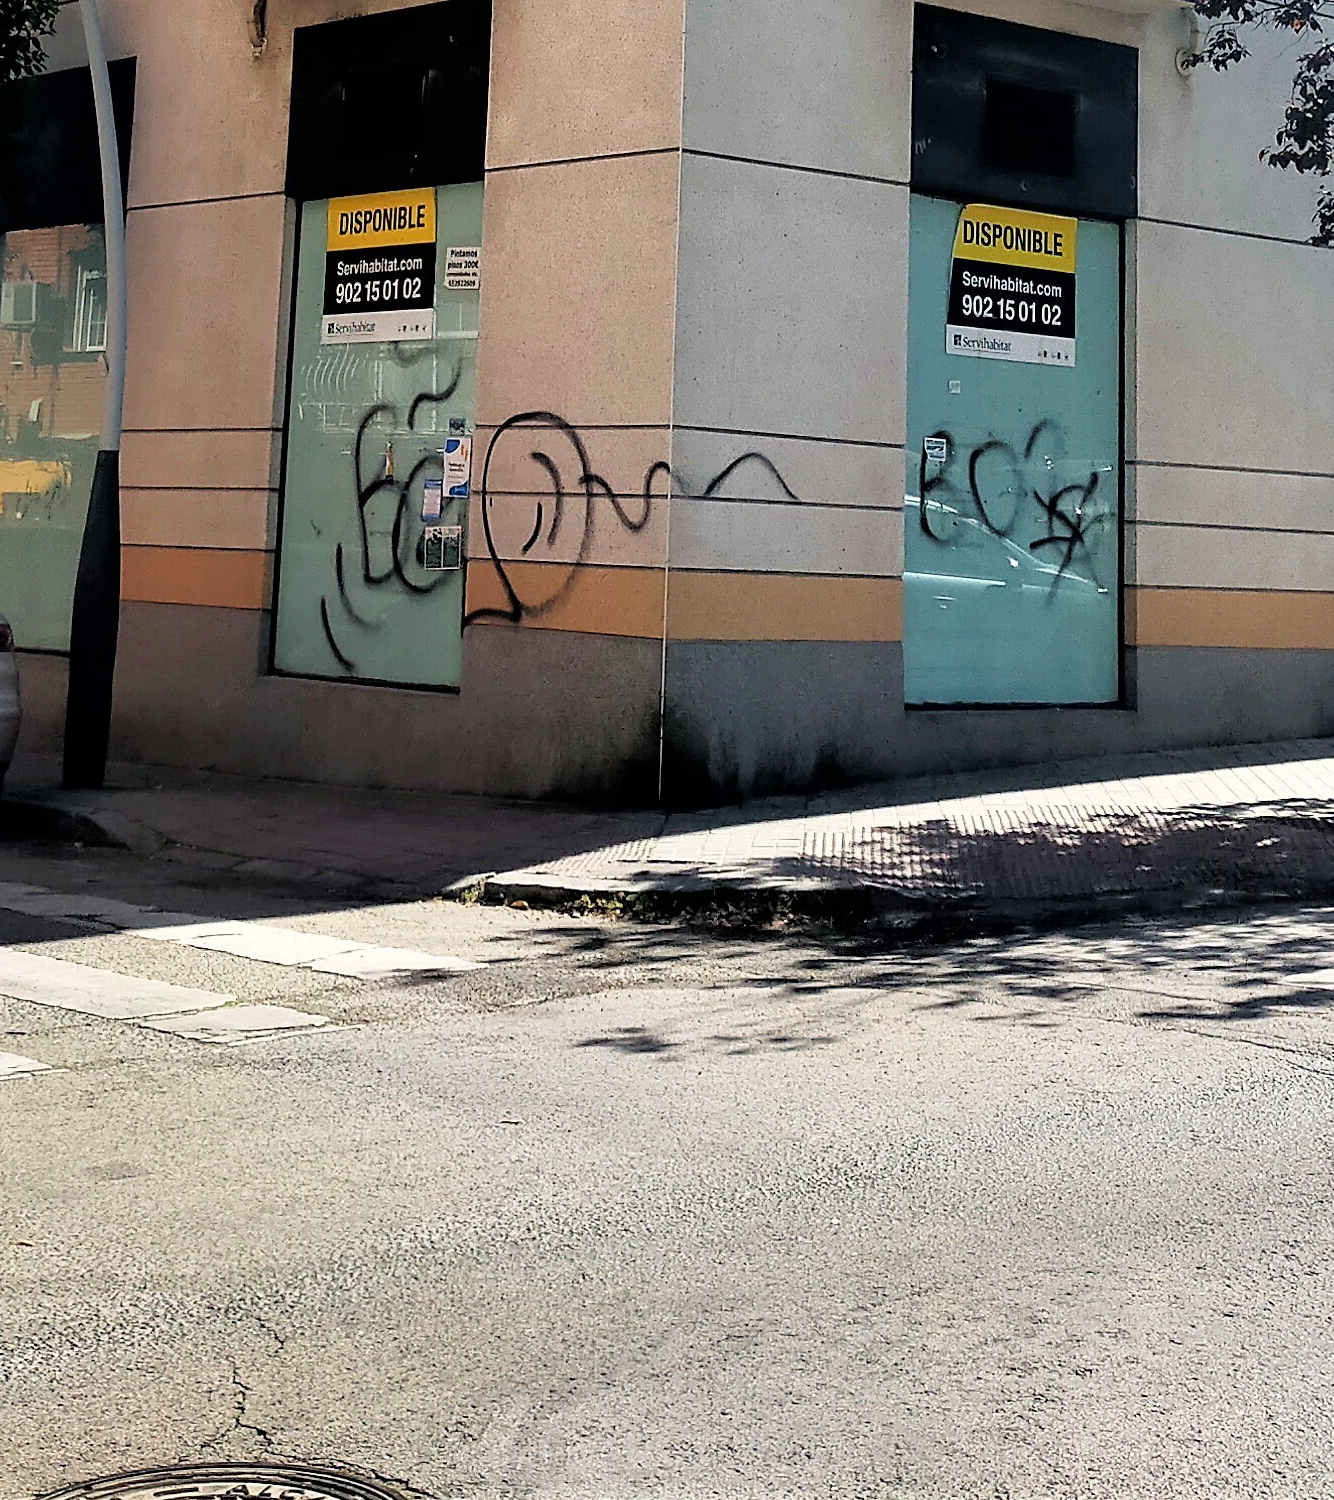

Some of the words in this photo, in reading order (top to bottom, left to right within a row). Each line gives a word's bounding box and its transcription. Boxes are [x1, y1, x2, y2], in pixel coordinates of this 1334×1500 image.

[339, 205, 426, 236] DISPONIBLE
[963, 219, 1063, 257] DISPONIBLE
[336, 258, 423, 276] Servihabitat.com
[335, 281, 362, 304] 902
[365, 280, 380, 302] 15
[382, 278, 399, 301] 01
[403, 277, 422, 299] 02
[962, 271, 1062, 298] Servihabitat.com
[962, 294, 993, 318] 902
[996, 298, 1015, 321] 15
[1018, 301, 1037, 323] 01
[1041, 303, 1062, 326] 02
[335, 321, 376, 334] Servihabitat
[963, 335, 1011, 352] Servihabitat
